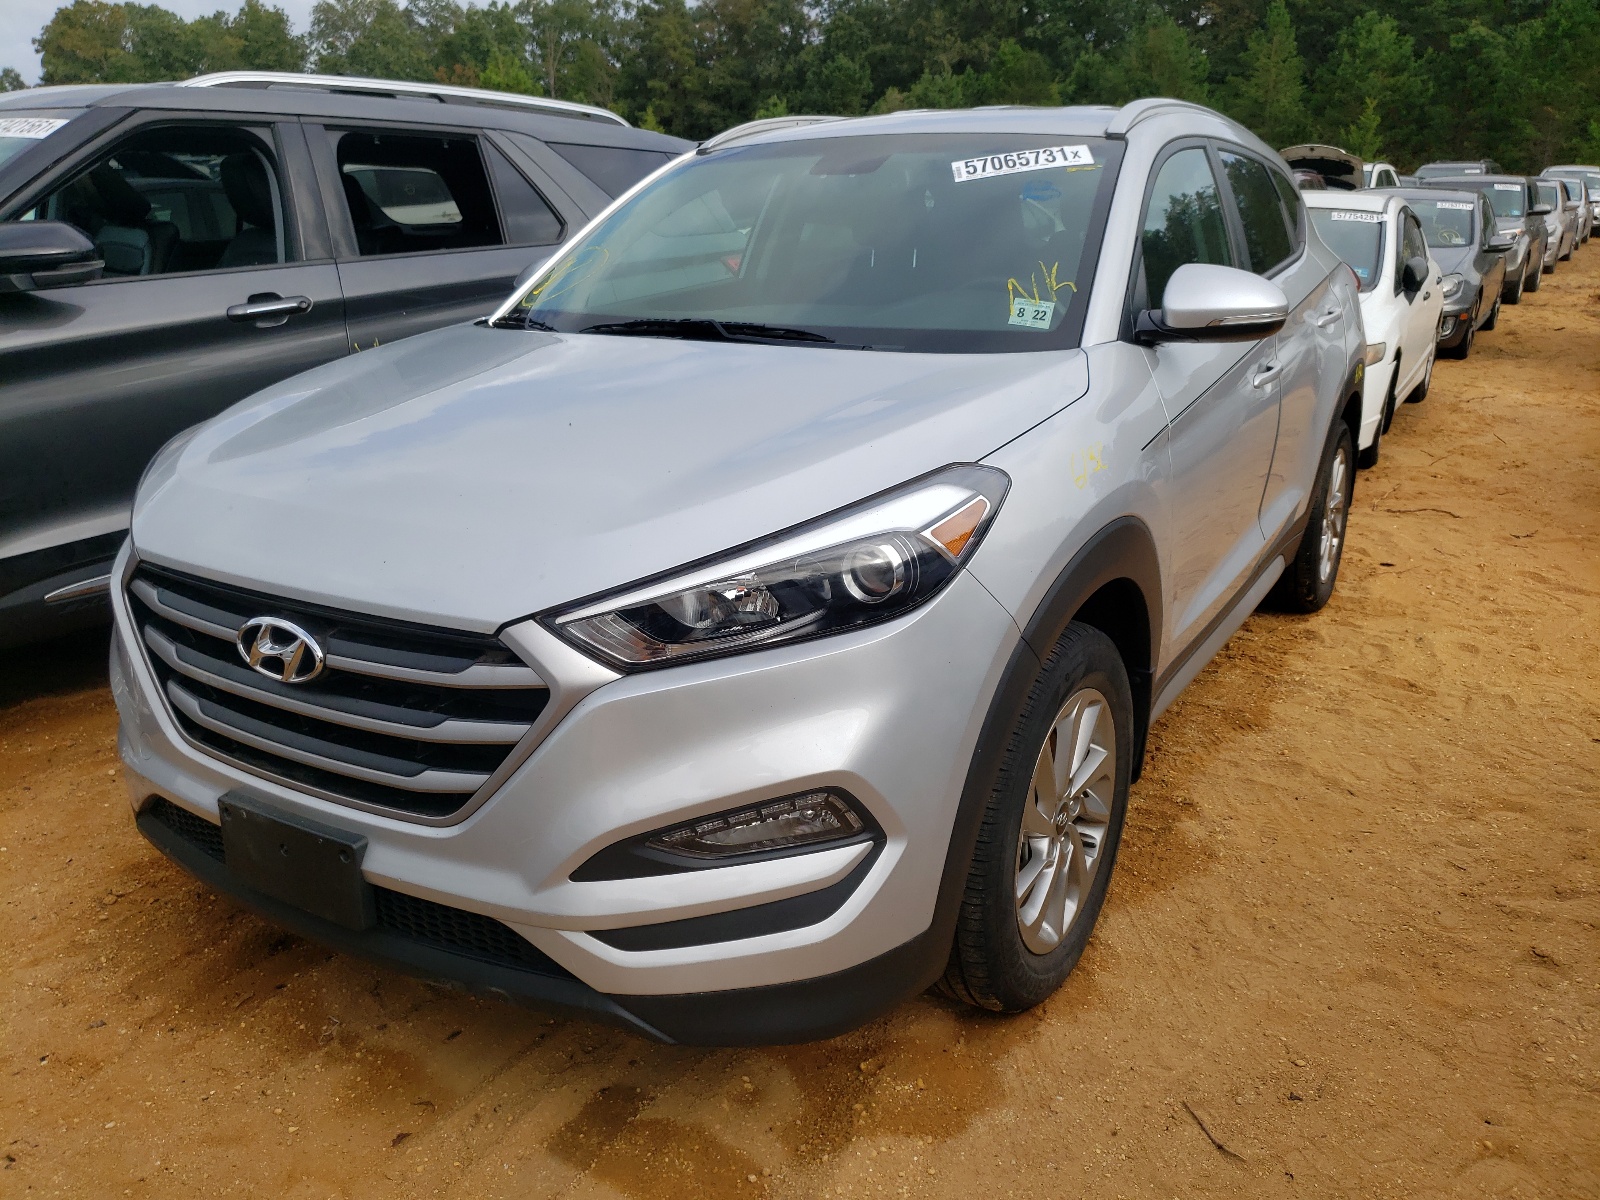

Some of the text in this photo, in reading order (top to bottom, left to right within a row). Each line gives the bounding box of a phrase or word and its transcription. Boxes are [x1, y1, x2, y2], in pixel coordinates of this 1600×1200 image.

[964, 148, 1069, 175] 57065731
[1016, 307, 1047, 321] 8 22
